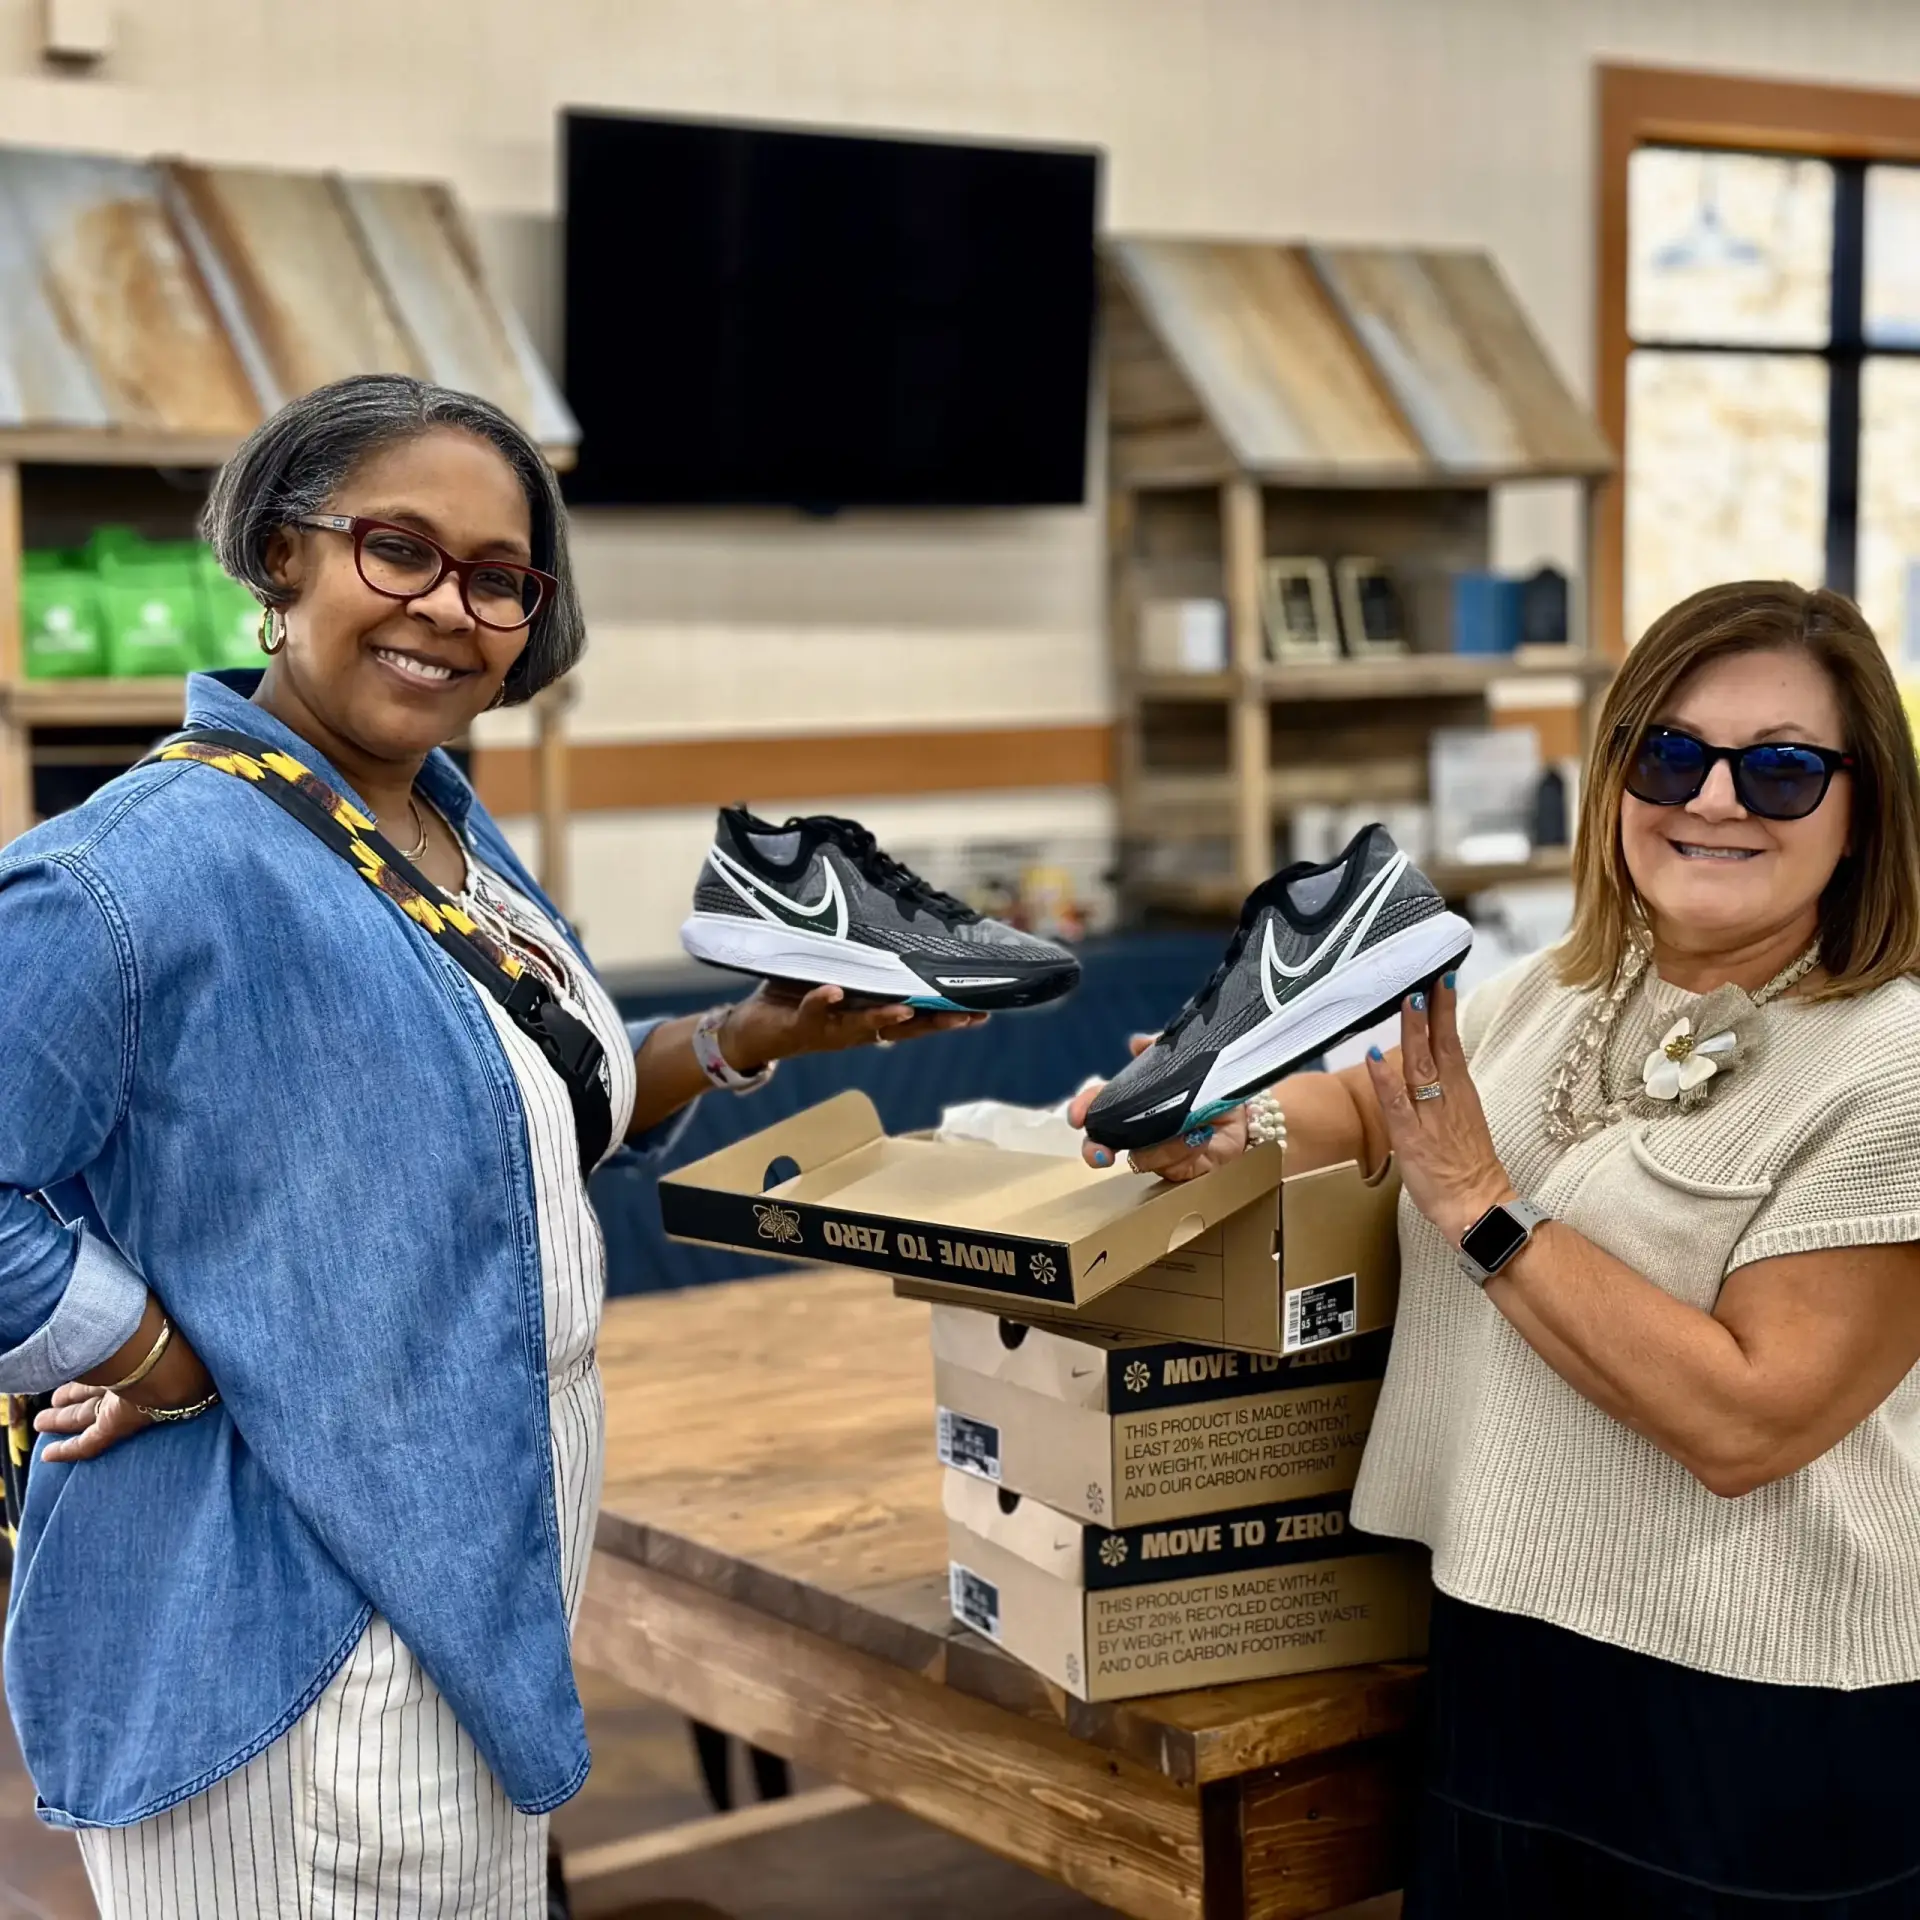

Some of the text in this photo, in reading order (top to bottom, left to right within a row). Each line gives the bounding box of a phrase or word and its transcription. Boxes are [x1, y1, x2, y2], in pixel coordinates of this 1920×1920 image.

[823, 1221, 1016, 1276] MOVE TO ZERO
[1163, 1352, 1238, 1386] MOVE
[1124, 1395, 1348, 1440] THIS PRODUCT IS MADE WITH AT
[1125, 1414, 1351, 1460] LEAST 20% RECYCLED CONTENT
[1125, 1464, 1145, 1480] BY
[1147, 1455, 1208, 1476] WEIGHT,
[1210, 1447, 1260, 1467] WHICH
[1262, 1438, 1330, 1460] REDUCES
[1125, 1484, 1157, 1501] AND
[1159, 1477, 1192, 1495] OUR
[1195, 1467, 1257, 1490] CARBON
[1141, 1510, 1345, 1560] MOVE TO ZERO
[1098, 1570, 1337, 1615] THIS PRODUCT IS MADE WITH AT
[1098, 1589, 1341, 1636] LEAST 20% RECYCLED CONTENT
[1098, 1605, 1370, 1656] BY WEIGHT, WHICH REDUCES WASTE
[1098, 1629, 1327, 1676] AND OUR CARBON FOOTPRINT.
